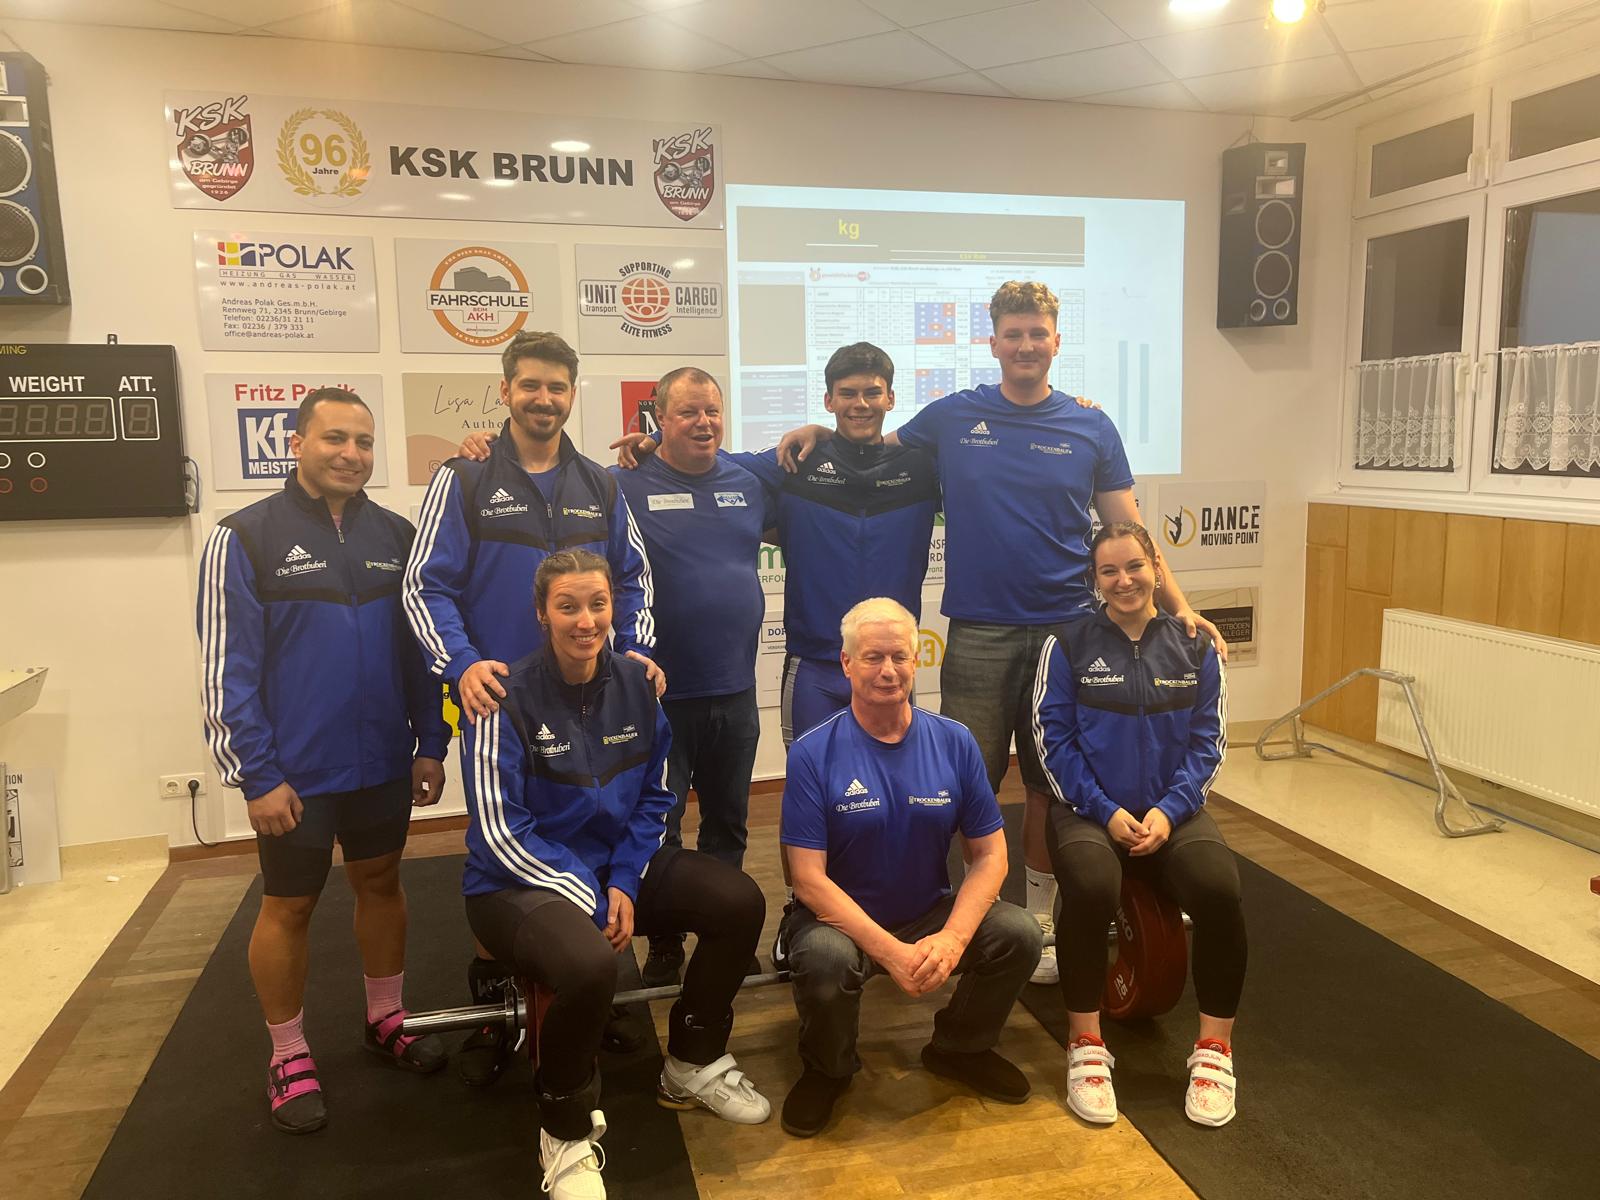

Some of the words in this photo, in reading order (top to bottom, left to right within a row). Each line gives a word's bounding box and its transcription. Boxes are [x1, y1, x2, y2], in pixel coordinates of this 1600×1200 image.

[175, 95, 248, 137] KSK
[299, 133, 347, 166] 96
[653, 127, 713, 164] KSK
[190, 160, 249, 177] BRUNN
[312, 167, 339, 176] Jahre
[389, 145, 479, 179] KSK
[493, 152, 634, 186] BRUNN
[663, 184, 710, 200] BRUNN
[838, 218, 860, 240] kg
[258, 243, 354, 270] POLAK
[618, 261, 671, 279] SUPPORTING
[220, 280, 356, 291] www.andreas-polak.at
[221, 298, 253, 306] Andreas
[255, 298, 275, 307] Polak
[430, 294, 529, 308] FAHRSCHULE
[675, 286, 718, 306] CARGO
[222, 306, 257, 315] Rennweg
[259, 307, 272, 315] 71,
[294, 308, 347, 317] Brunn/Gebirge
[467, 312, 494, 321] AKH
[585, 305, 617, 313] Transport
[676, 306, 718, 315] Intelligence
[223, 314, 254, 322] Telefon:
[223, 322, 240, 330] Fax:
[274, 323, 288, 331] 379
[620, 322, 641, 338] ELITE
[641, 323, 673, 339] FITNESS
[224, 330, 315, 339] office@andreas-polak.at
[8, 375, 85, 393] WEIGHT
[118, 375, 157, 392] ATT.
[234, 383, 286, 402] Fritz
[433, 384, 474, 415] Lisa
[482, 385, 504, 415] La
[461, 419, 504, 429] Autho
[248, 461, 299, 475] MEISTE
[489, 495, 515, 504] adidas
[1201, 505, 1261, 532] DANCE
[1201, 532, 1233, 546] MOVING
[1235, 531, 1260, 545] POINT
[285, 553, 312, 563] adidas
[844, 788, 869, 797] adidas
